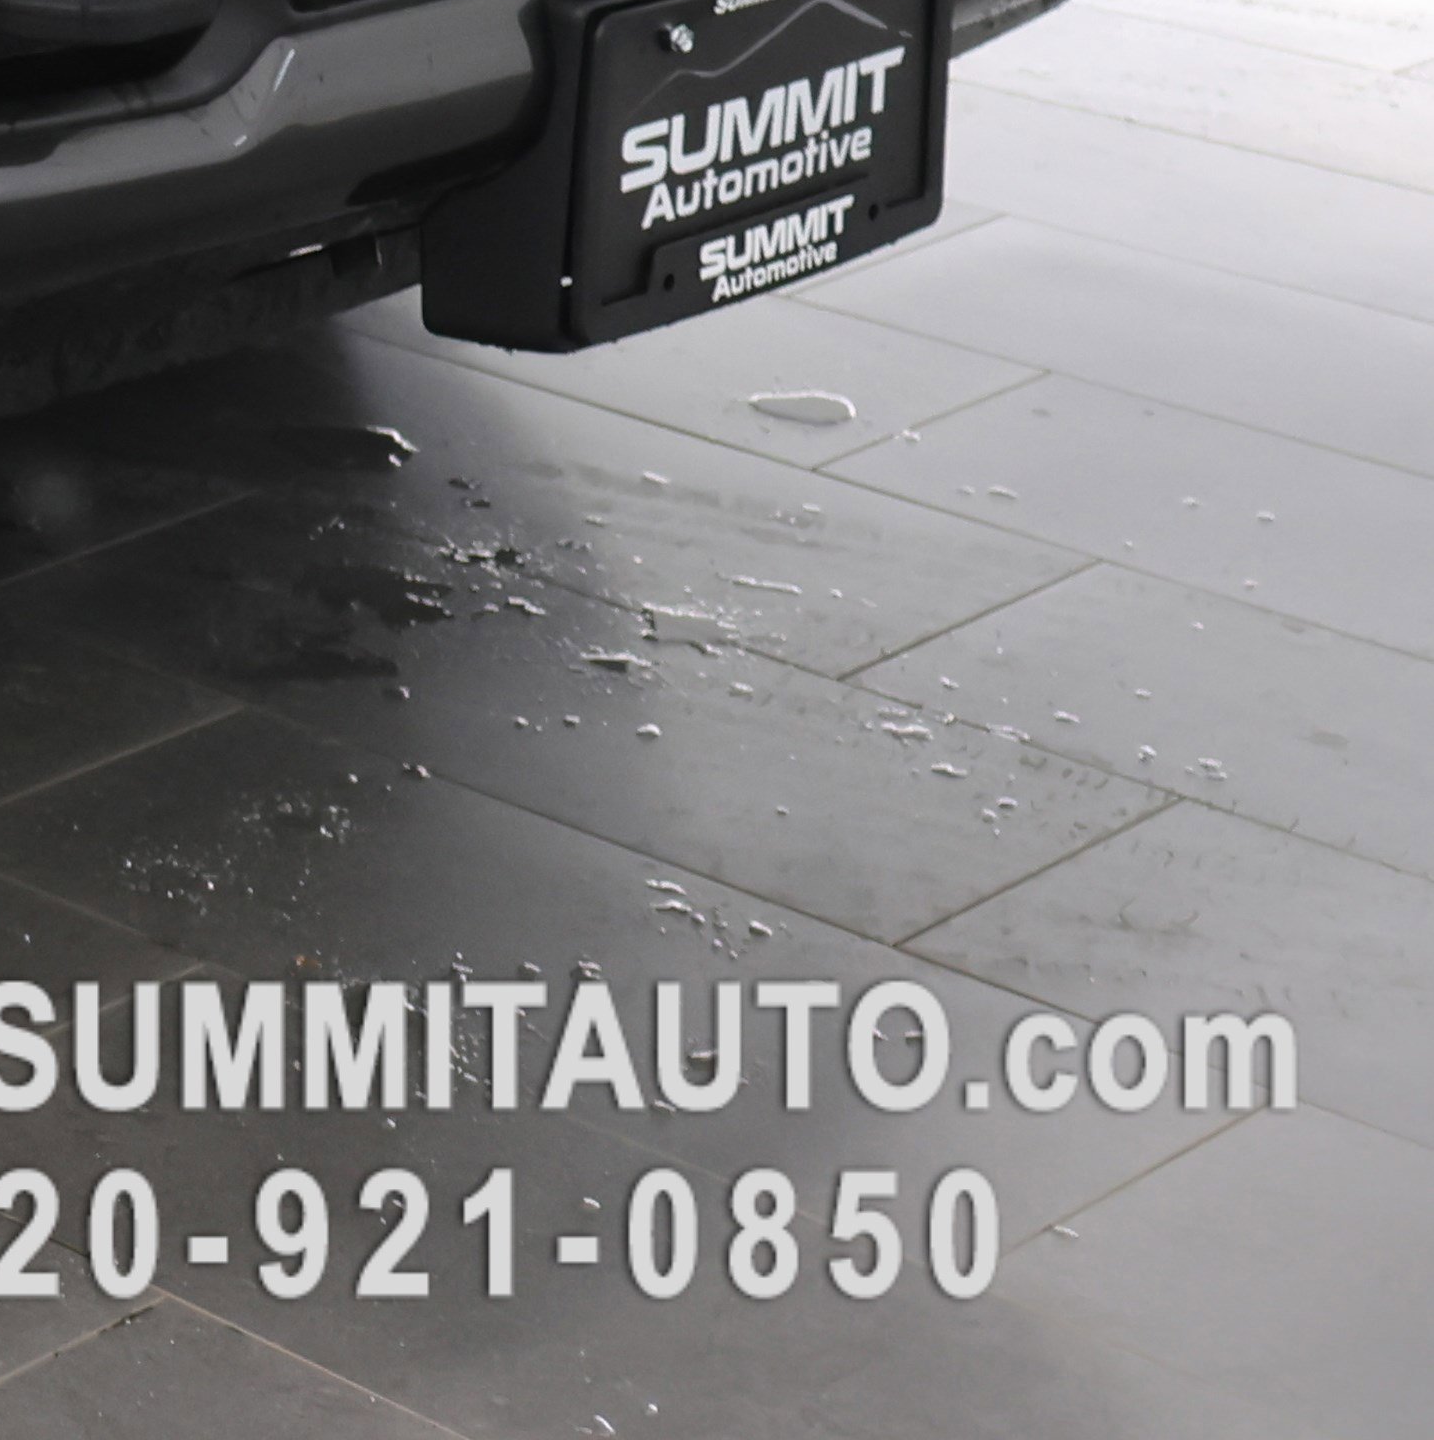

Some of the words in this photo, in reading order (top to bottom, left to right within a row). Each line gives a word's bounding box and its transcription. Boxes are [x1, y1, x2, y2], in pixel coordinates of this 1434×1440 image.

[620, 46, 906, 194] SUMMIT
[641, 126, 873, 231] Automotive
[699, 194, 855, 282] SUMMIT
[711, 238, 839, 303] Automotive
